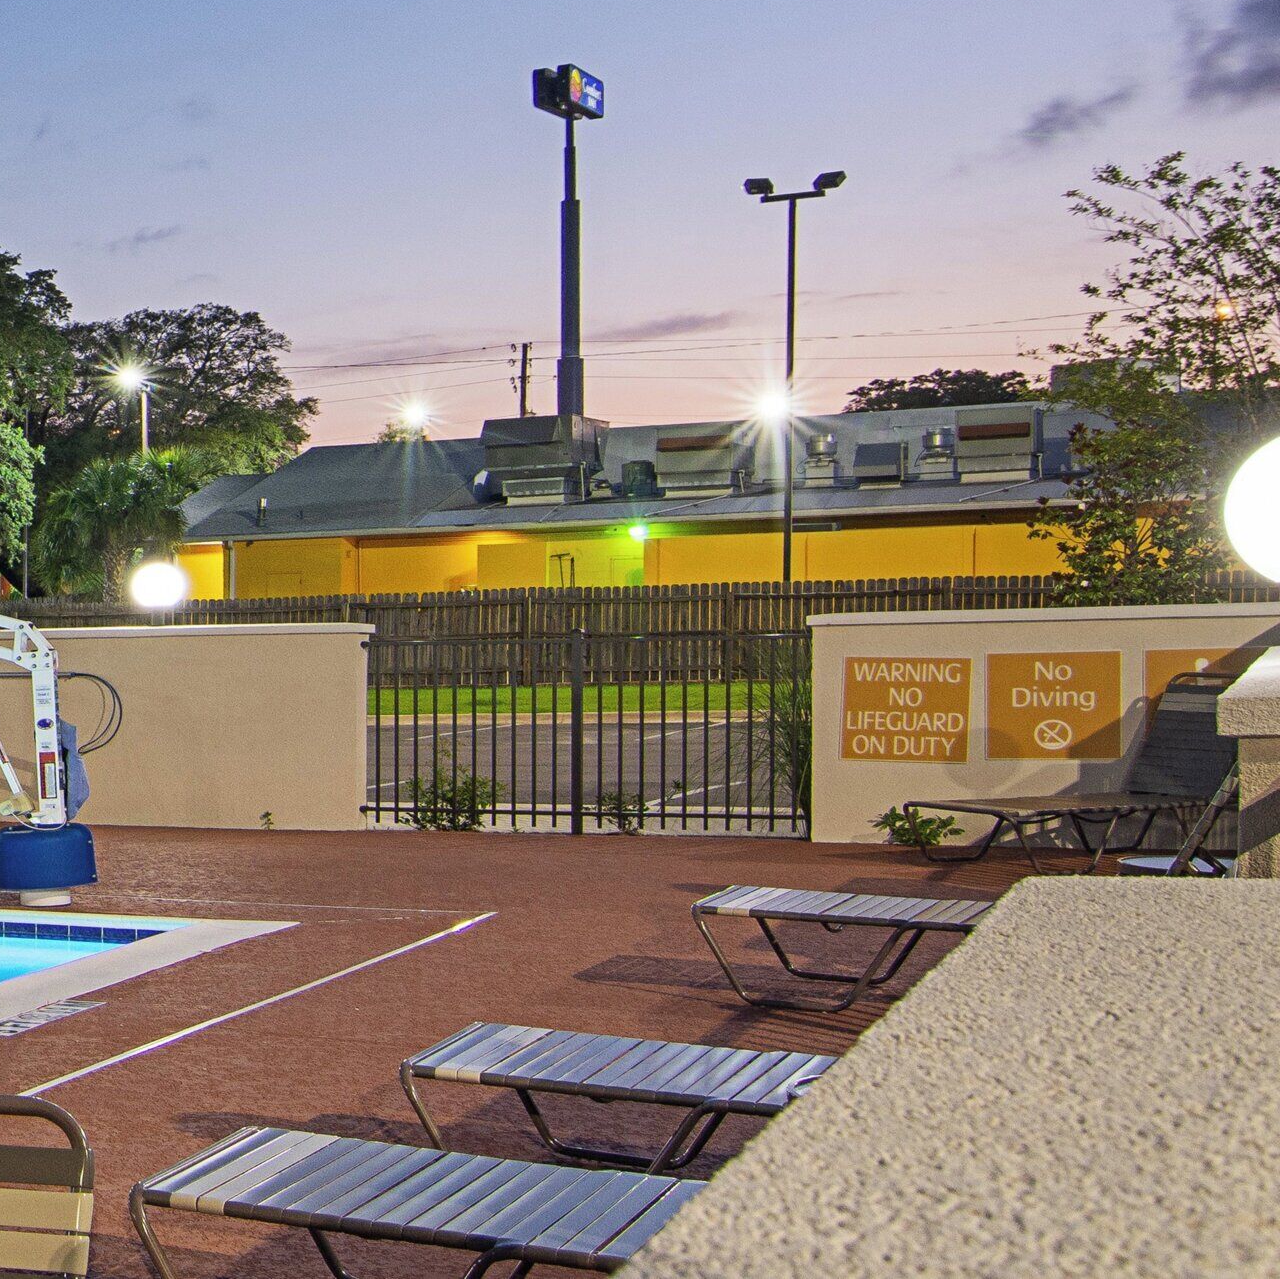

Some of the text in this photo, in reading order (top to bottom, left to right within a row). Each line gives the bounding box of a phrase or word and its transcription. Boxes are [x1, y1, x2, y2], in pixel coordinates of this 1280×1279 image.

[853, 662, 962, 683] WARNING
[1034, 661, 1072, 681] No
[889, 687, 923, 707] NO
[1011, 685, 1095, 712] Diving
[846, 711, 964, 732] LIFEGUARD
[851, 734, 956, 756] ON DUTY
